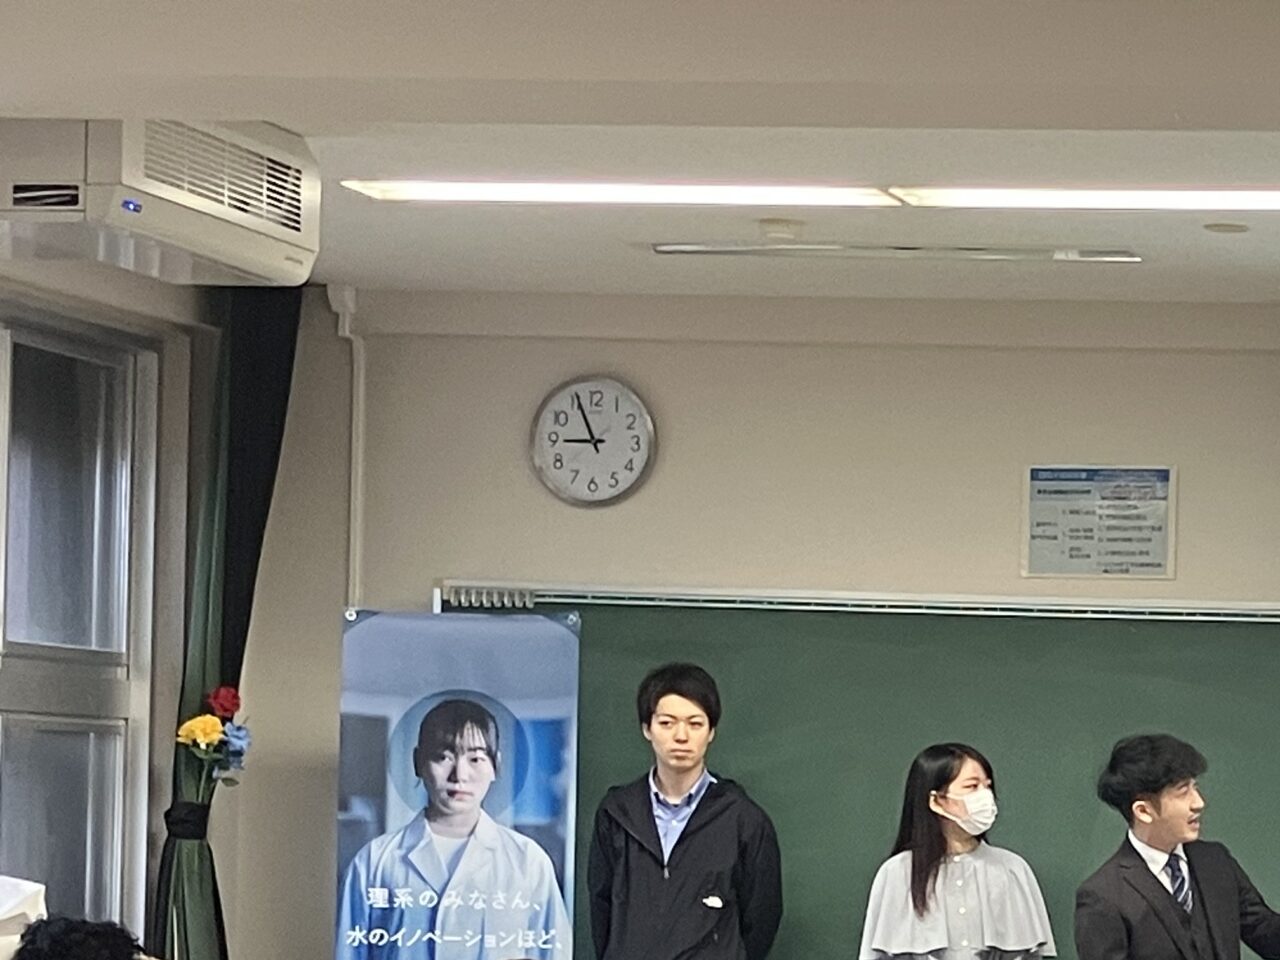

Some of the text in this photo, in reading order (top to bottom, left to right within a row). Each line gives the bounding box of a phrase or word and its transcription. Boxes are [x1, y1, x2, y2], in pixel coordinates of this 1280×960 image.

[589, 390, 604, 407] 12
[554, 410, 569, 427] 10
[626, 413, 637, 430] 2
[548, 432, 559, 448] 9
[631, 435, 641, 452] 3
[553, 453, 563, 470] 8
[624, 459, 634, 472] 4
[570, 469, 579, 485] 7
[587, 476, 598, 493] 6
[608, 472, 619, 488] 5
[367, 887, 541, 910] 理系のみなさん、
